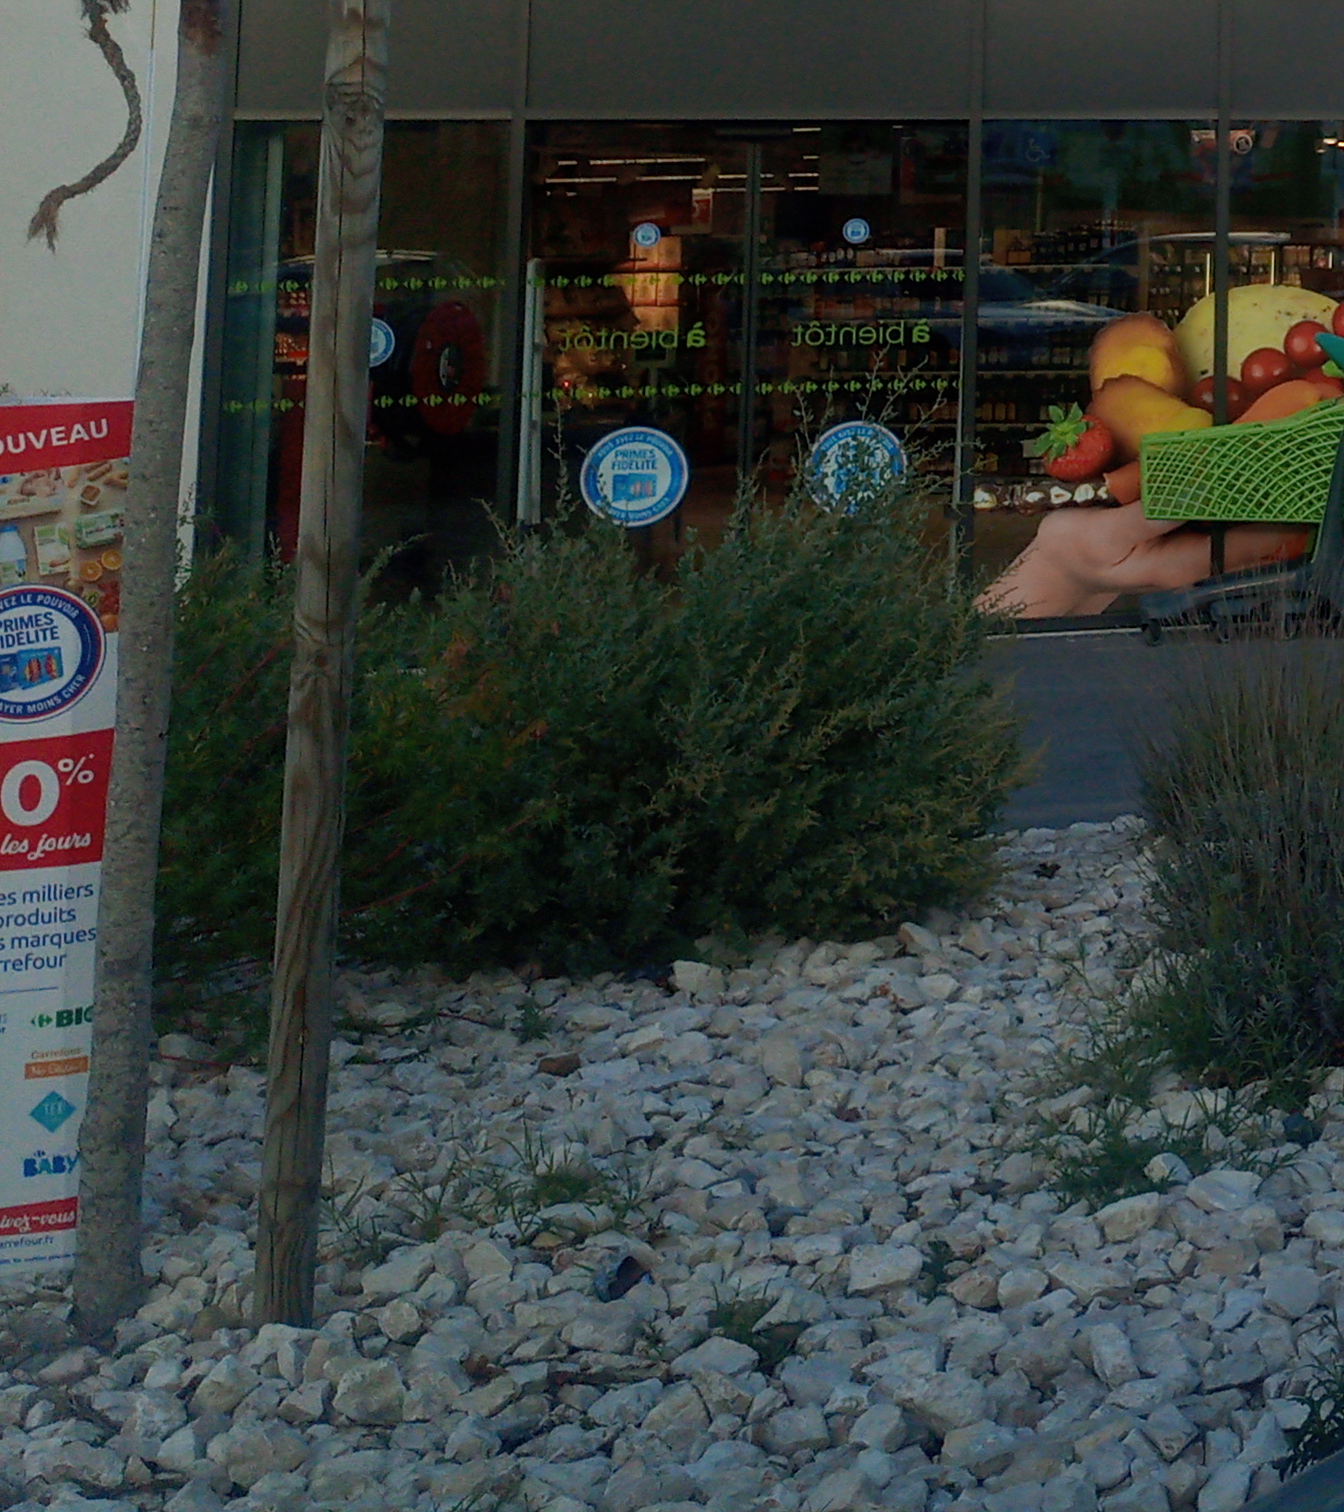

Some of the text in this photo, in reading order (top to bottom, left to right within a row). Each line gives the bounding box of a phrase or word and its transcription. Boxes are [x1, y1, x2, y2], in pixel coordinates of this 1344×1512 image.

[21, 594, 32, 603] LE
[27, 696, 61, 714] MOINS
[0, 833, 91, 861] les jours
[22, 884, 94, 904] milliers
[11, 928, 97, 950] marques
[0, 953, 67, 973] refour
